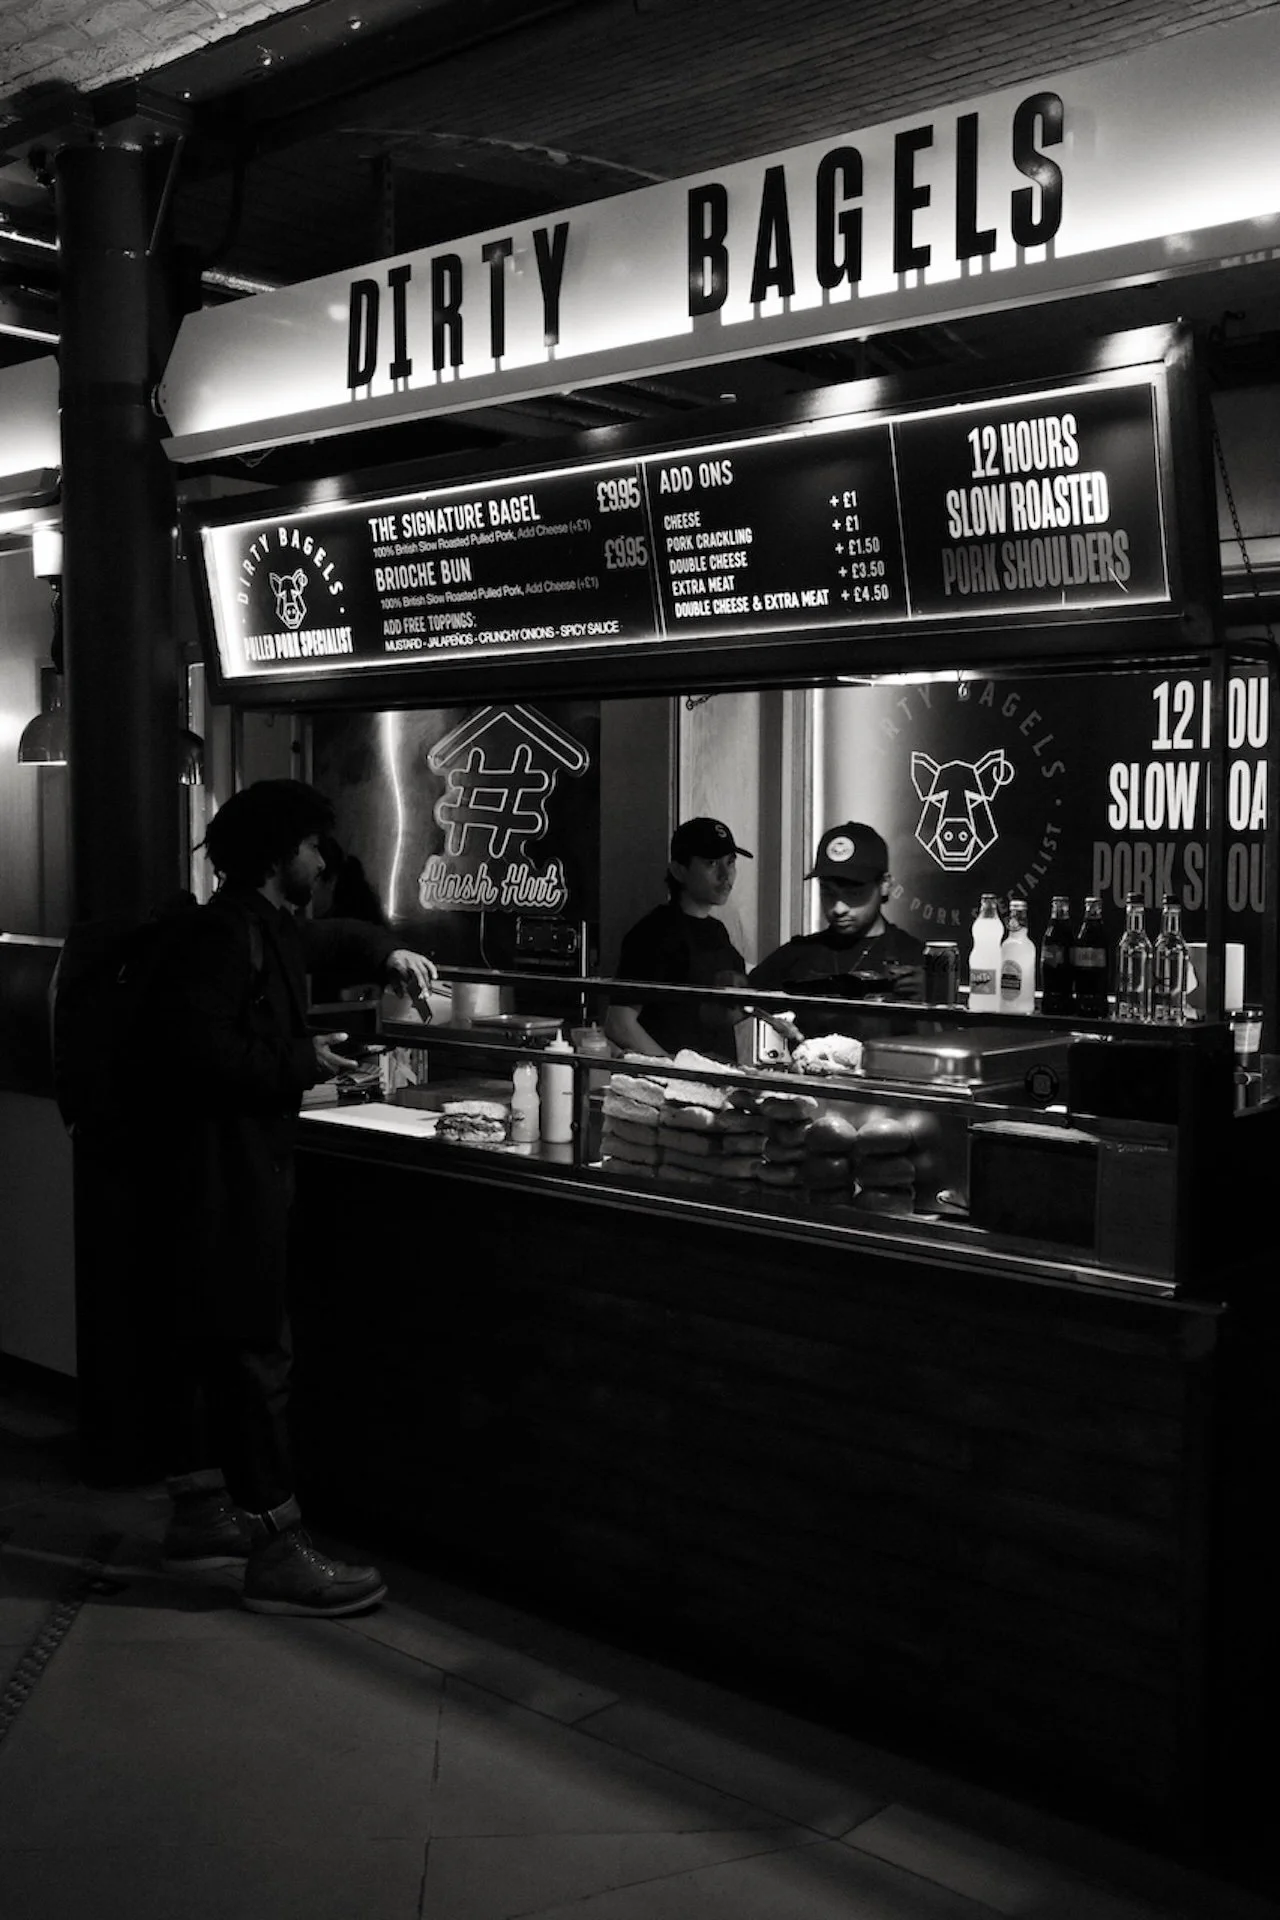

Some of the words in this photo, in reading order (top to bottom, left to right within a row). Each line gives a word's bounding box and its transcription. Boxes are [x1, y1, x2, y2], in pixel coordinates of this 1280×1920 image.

[347, 222, 570, 389] DIRTY
[687, 91, 1064, 316] BAGELS
[967, 425, 1000, 479] 12
[1001, 413, 1079, 474] HOURS
[660, 465, 693, 494] ADD
[699, 460, 733, 488] ONS
[368, 515, 398, 542] THE
[401, 502, 485, 539] SIGNATURE
[488, 494, 541, 526] BAGEL
[664, 511, 701, 530] CHEESE
[843, 490, 857, 508] £1
[946, 483, 1006, 539] SLOW
[1010, 471, 1110, 532] ROASTED
[439, 534, 469, 549] Roasted
[470, 531, 494, 546] Pulled
[536, 523, 568, 536] Cheese
[666, 535, 694, 553] PORK
[696, 527, 753, 549] CRACKLING
[845, 514, 859, 532] £1
[237, 534, 269, 605] DIRTY
[278, 527, 343, 595] BAGELS
[375, 561, 437, 592] BRIOCHE
[440, 557, 472, 585] BUN
[669, 556, 707, 575] DOUBLE
[709, 551, 748, 570] CHEESE
[848, 536, 880, 556] £1.50
[942, 543, 1000, 596] PORK
[1002, 529, 1131, 591] SHOULDERS
[445, 590, 477, 603] Roasted
[478, 586, 502, 600] Pulled
[543, 580, 576, 593] Cheese
[672, 578, 706, 596] EXTRA
[708, 575, 735, 592] MEAT
[852, 560, 885, 579] £3.50
[675, 600, 712, 618] DOUBLE
[713, 596, 749, 615] CHEESE
[752, 595, 763, 611] &
[764, 592, 799, 611] EXTRA
[800, 589, 829, 607] MEAT
[853, 584, 889, 602] £4.50
[383, 619, 401, 636] ADD
[403, 616, 426, 634] FREE
[427, 611, 477, 632] TOPPINGS:
[385, 637, 422, 652] MUSTARD
[478, 629, 520, 645] CRUNCHY
[520, 626, 554, 641] ONIONS
[560, 623, 587, 638] SPICY
[587, 620, 619, 636] SAUCE
[1151, 679, 1196, 750] 12
[1107, 761, 1200, 831] SLOW
[421, 862, 498, 905] Hash
[501, 863, 561, 906] Hut
[1092, 841, 1176, 909] PORK
